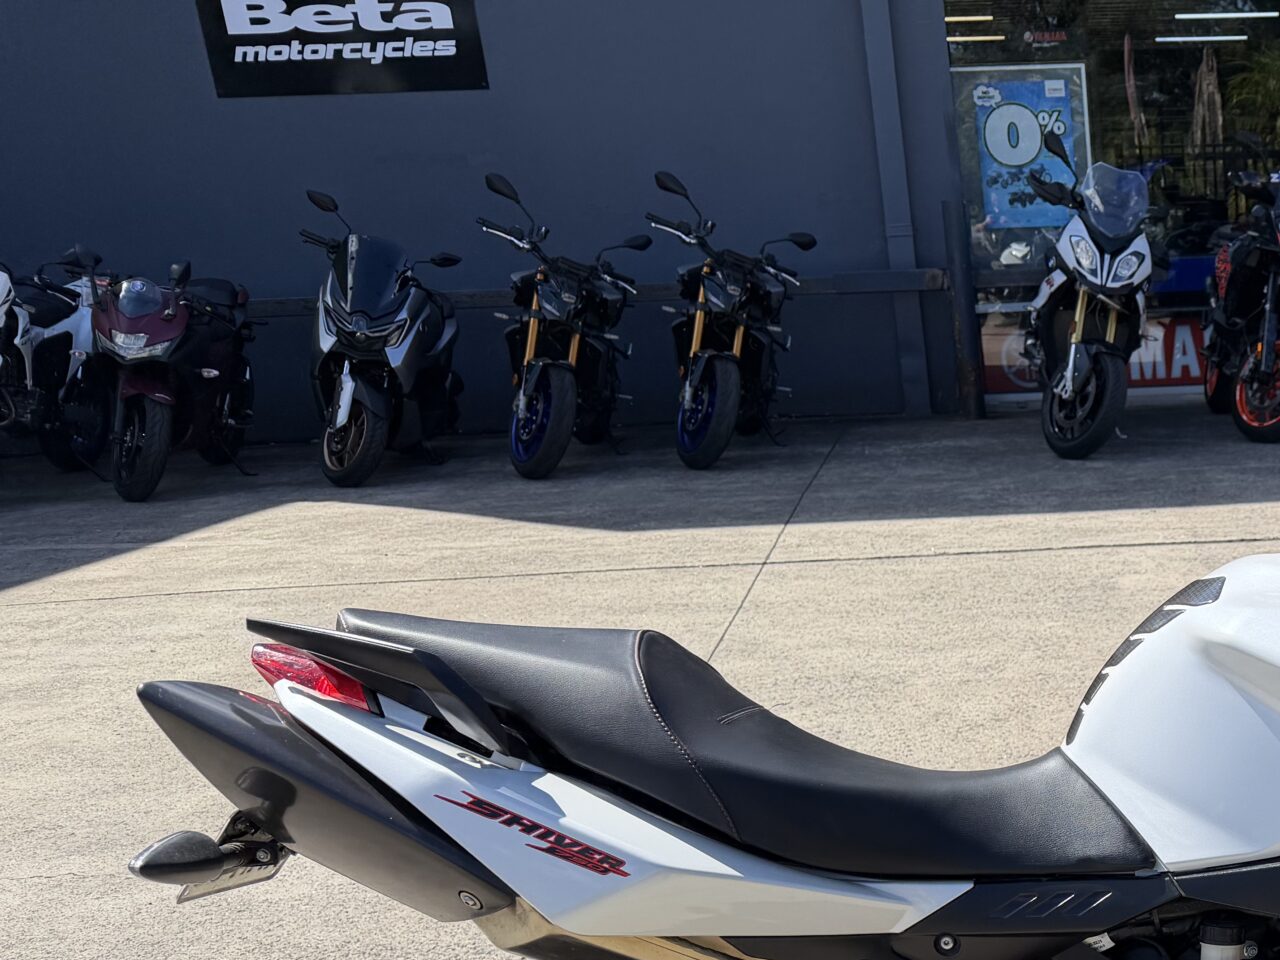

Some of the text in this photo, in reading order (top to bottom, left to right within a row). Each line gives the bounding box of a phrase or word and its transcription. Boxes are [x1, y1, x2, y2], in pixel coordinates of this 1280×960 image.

[221, 0, 454, 35] Beta
[234, 37, 456, 64] motorcycles
[433, 790, 629, 873] SHIVER
